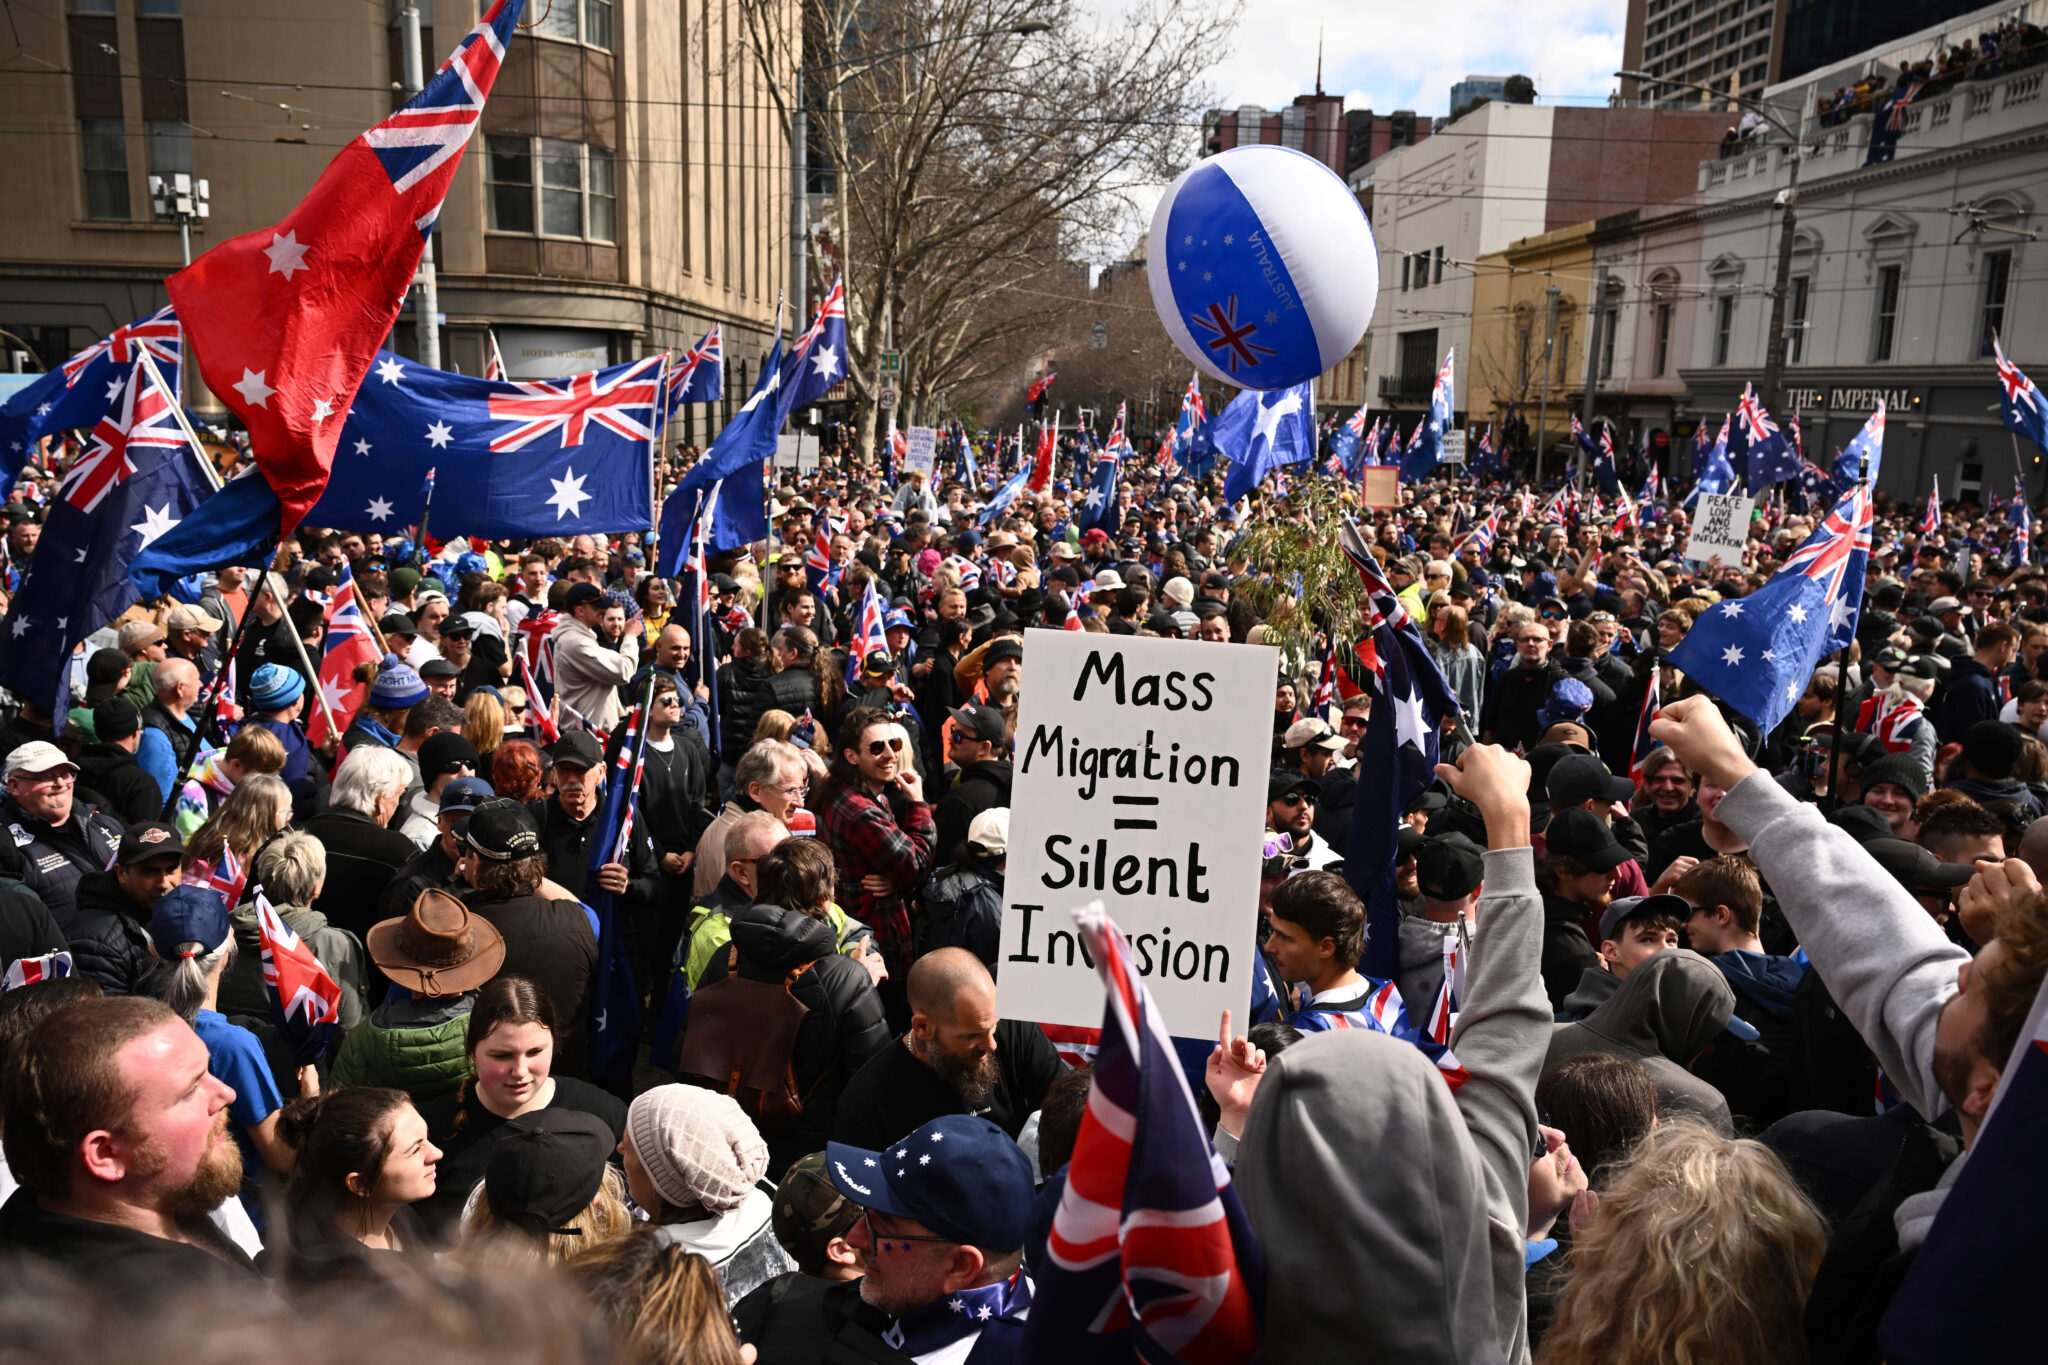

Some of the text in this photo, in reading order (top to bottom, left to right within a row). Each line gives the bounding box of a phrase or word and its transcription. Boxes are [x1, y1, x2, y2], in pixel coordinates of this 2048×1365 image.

[1248, 230, 1298, 311] AUSTRALIA
[521, 348, 596, 359] HOTEL WINDSOR
[883, 394, 894, 403] 40
[1786, 388, 1911, 411] THE IMPERIAL
[1707, 495, 1742, 509] PEACE
[1710, 507, 1733, 518] LOVE
[1709, 517, 1731, 527] AND
[1702, 525, 1731, 537] MASS
[1693, 533, 1743, 549] INFLATION
[378, 676, 405, 686] FIGHT
[1073, 651, 1216, 711] Mass
[1021, 724, 1240, 800] Migration
[1041, 835, 1210, 903] Silent
[1008, 904, 1230, 983] Insion
[834, 1161, 871, 1196] Australia
